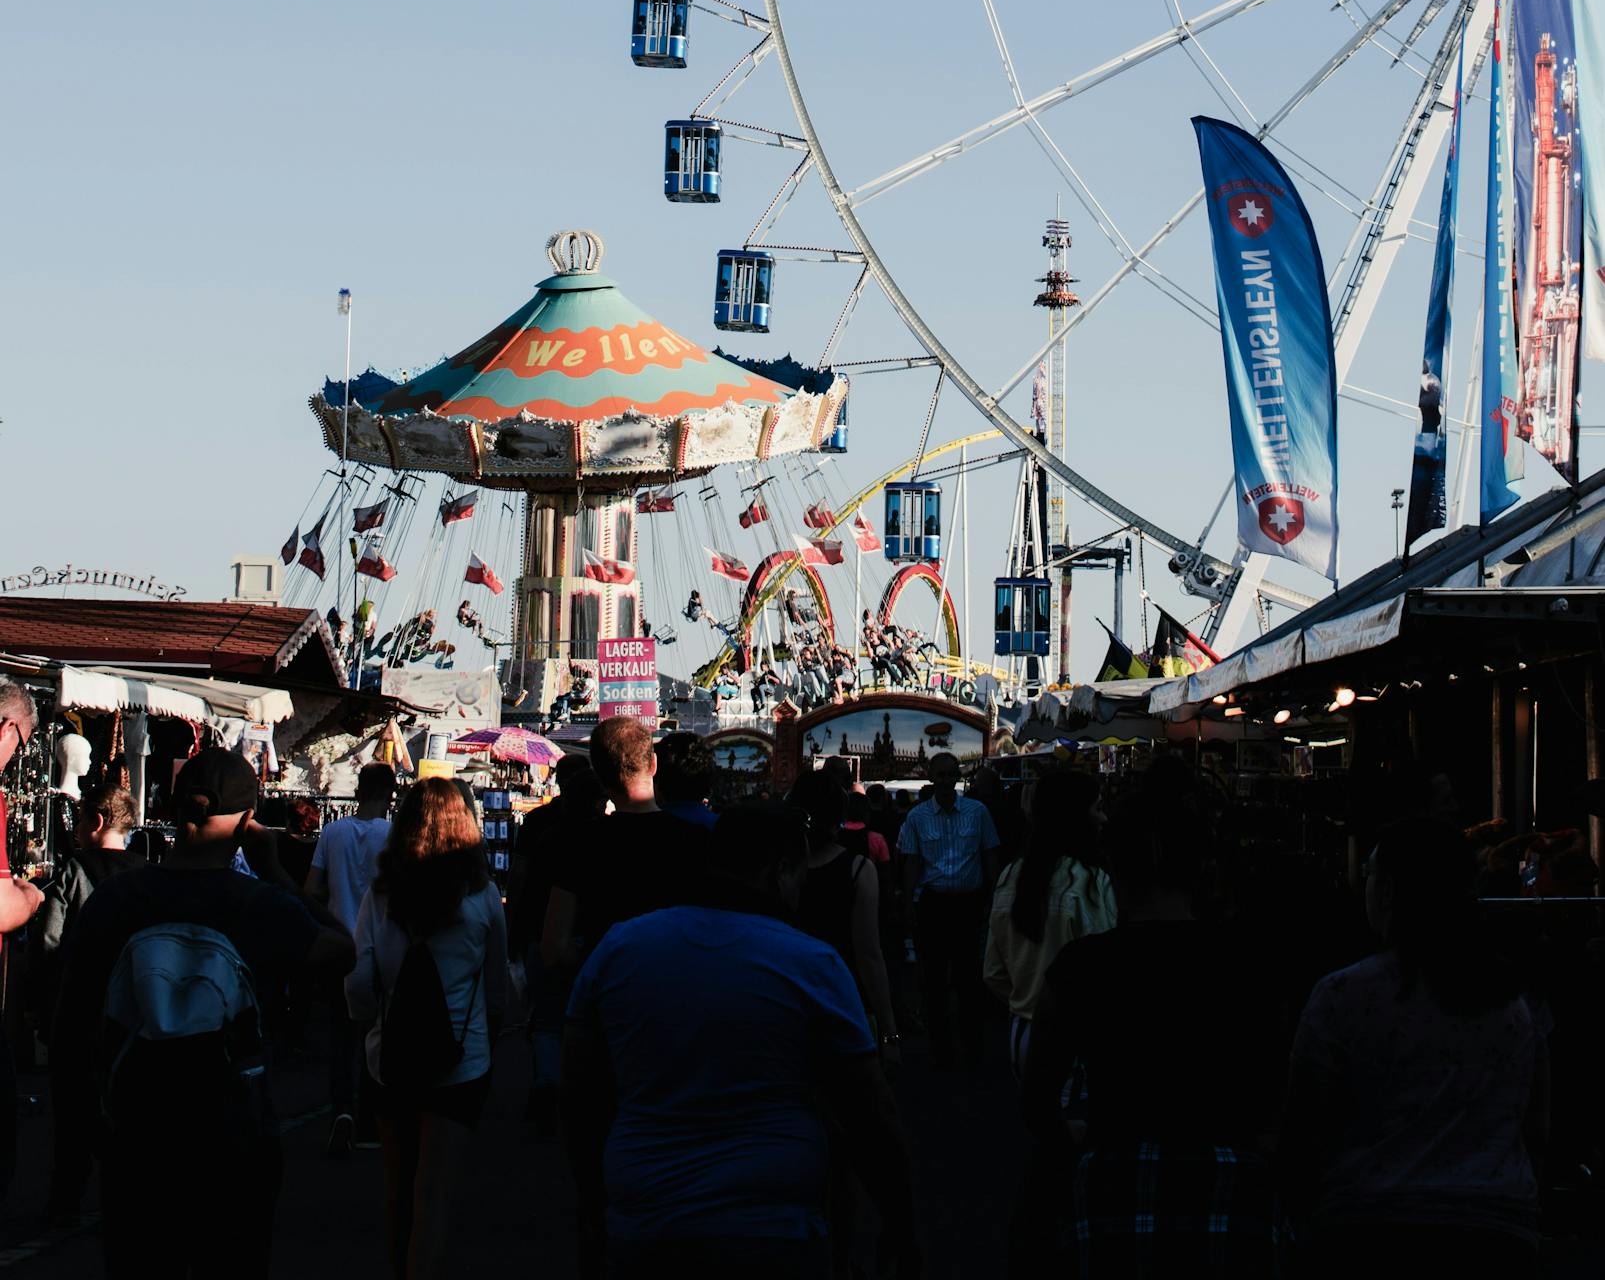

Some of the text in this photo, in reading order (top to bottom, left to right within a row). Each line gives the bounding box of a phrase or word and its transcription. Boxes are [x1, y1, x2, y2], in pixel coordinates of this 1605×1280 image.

[605, 641, 650, 658] LAGER-
[600, 661, 655, 678] VERKAUF
[603, 683, 653, 701] Socken
[614, 704, 643, 716] EIGENE
